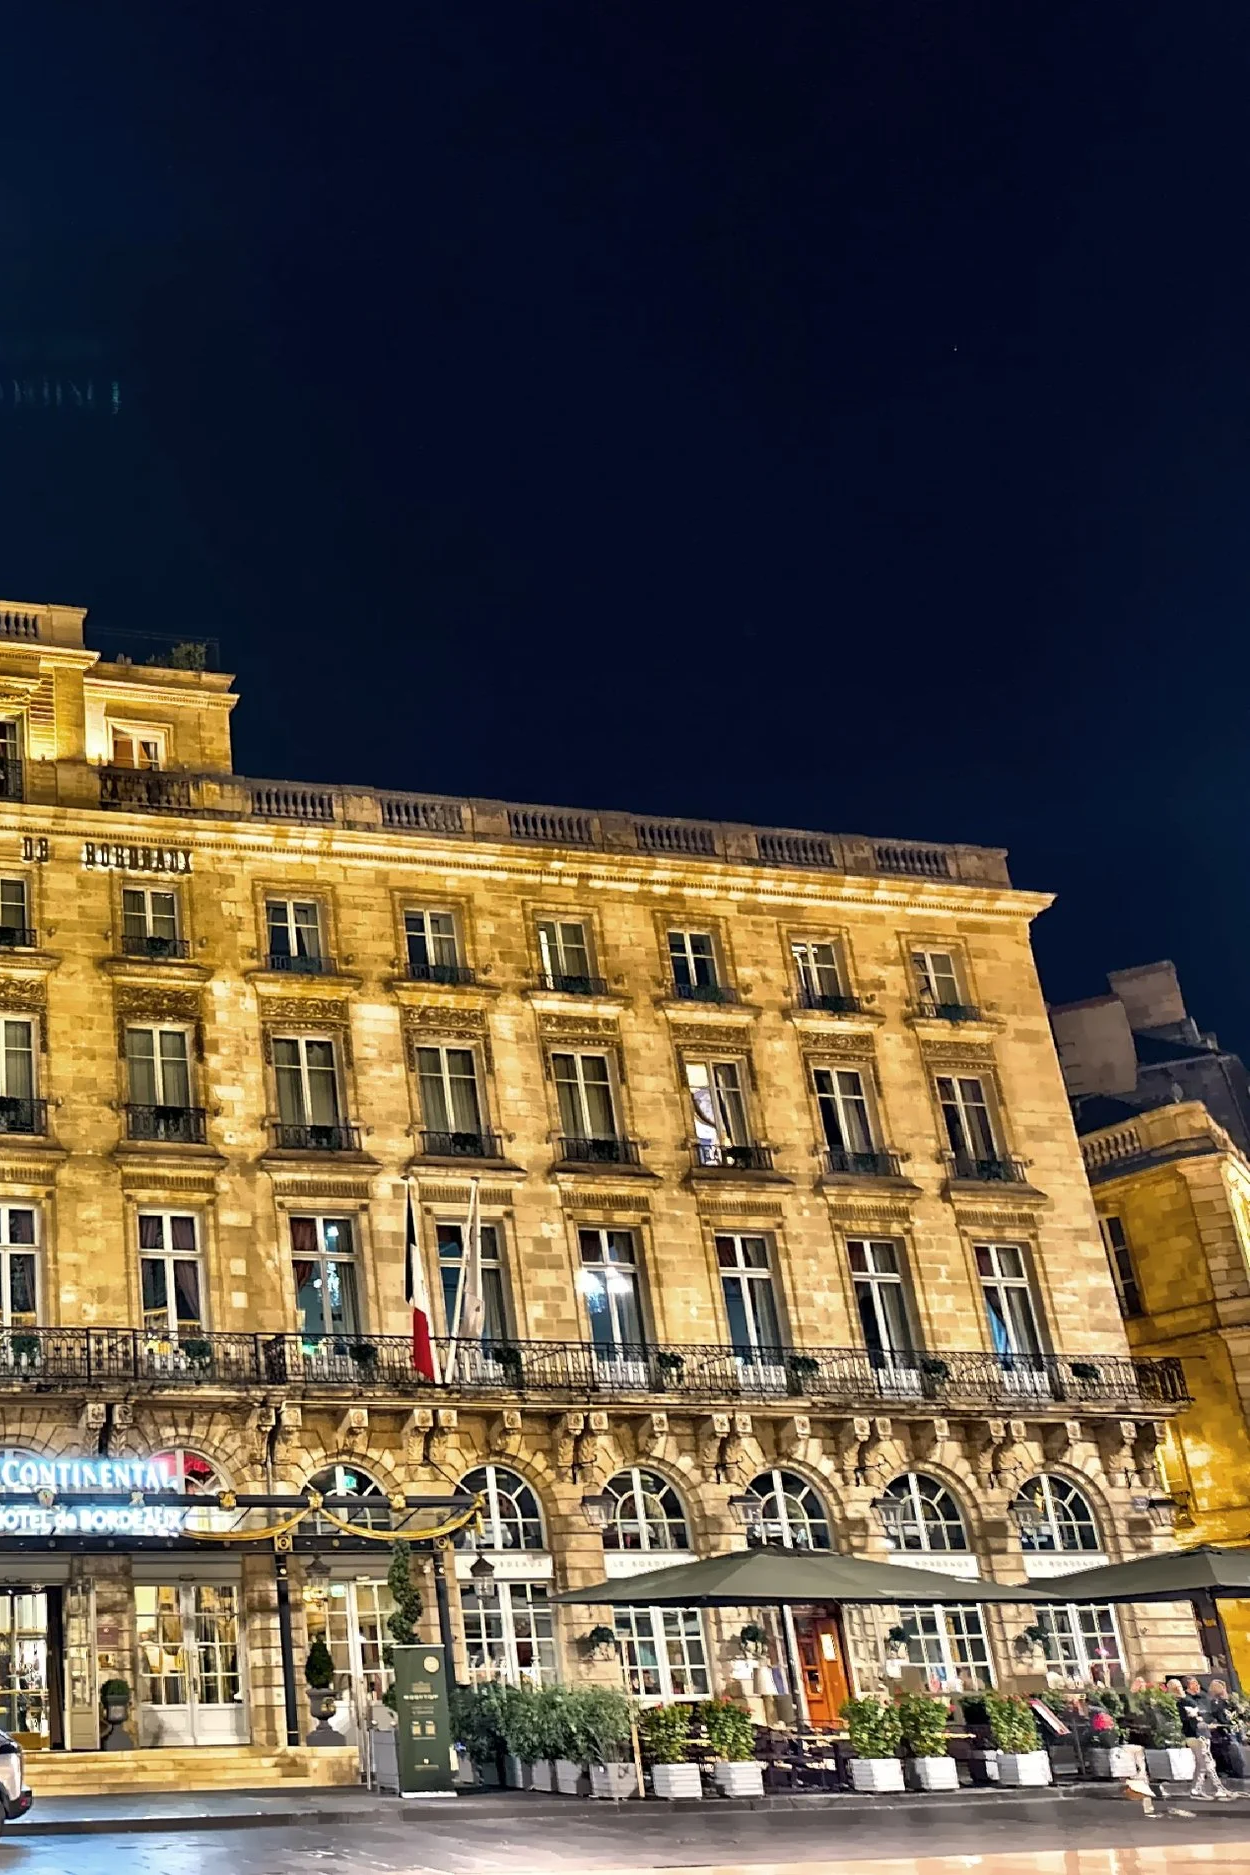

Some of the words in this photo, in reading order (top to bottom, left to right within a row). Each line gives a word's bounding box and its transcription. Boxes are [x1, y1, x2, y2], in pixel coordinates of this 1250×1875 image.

[23, 837, 49, 862] DE
[85, 842, 191, 874] BORDEAUX
[55, 1509, 78, 1530] de
[80, 1508, 184, 1531] BORDEAUX
